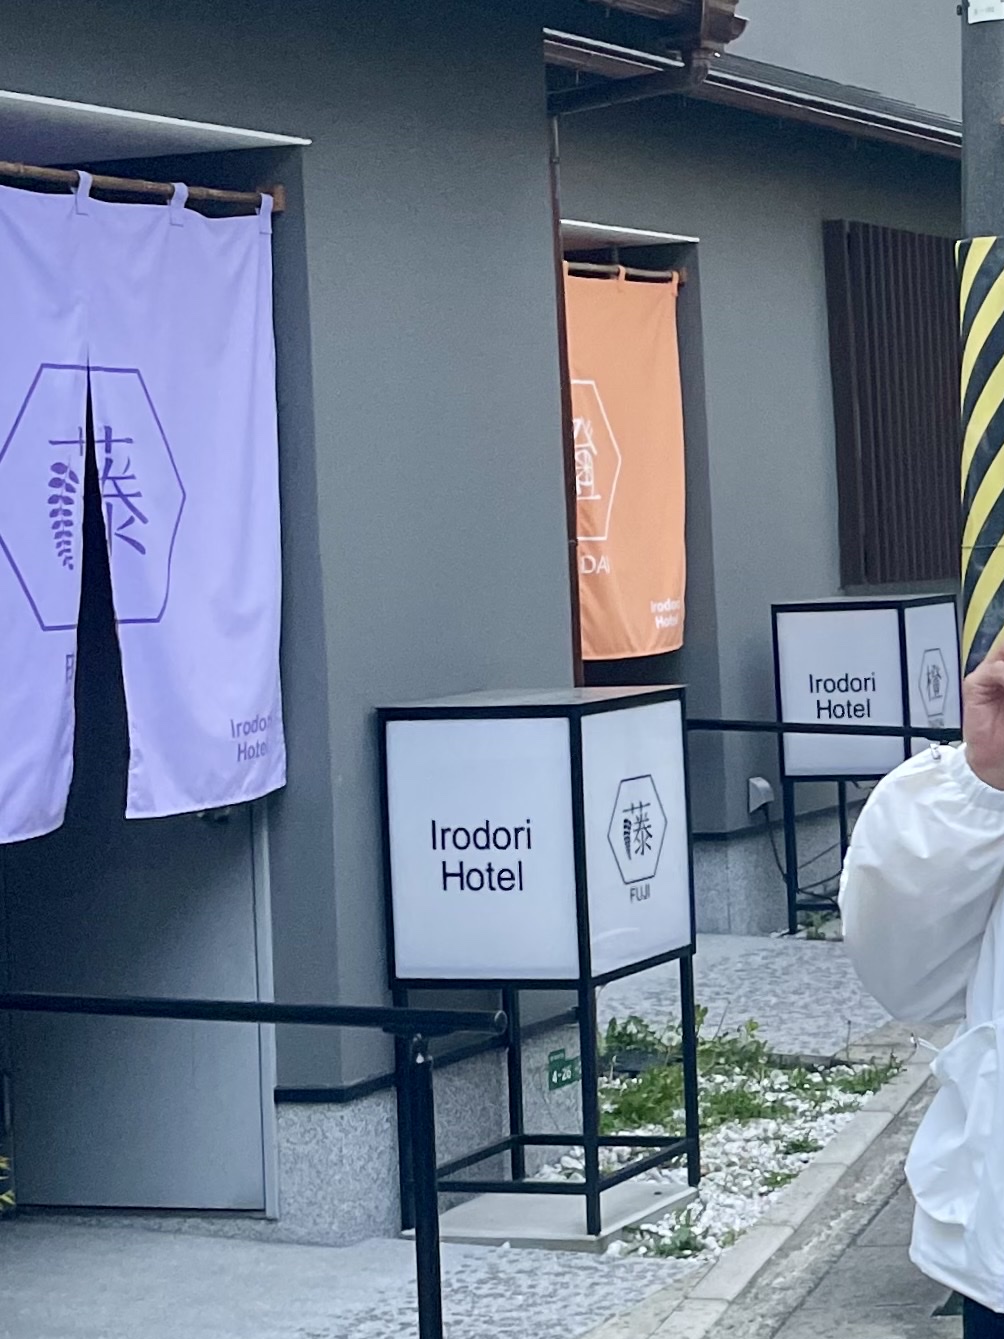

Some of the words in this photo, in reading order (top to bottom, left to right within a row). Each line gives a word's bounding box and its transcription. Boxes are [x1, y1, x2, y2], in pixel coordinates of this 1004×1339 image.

[808, 671, 877, 694] Irodori
[816, 698, 871, 720] Hotel
[431, 818, 532, 851] Irodori
[622, 800, 653, 860] 藤
[441, 860, 524, 892] Hotel
[629, 884, 651, 903] FUJI
